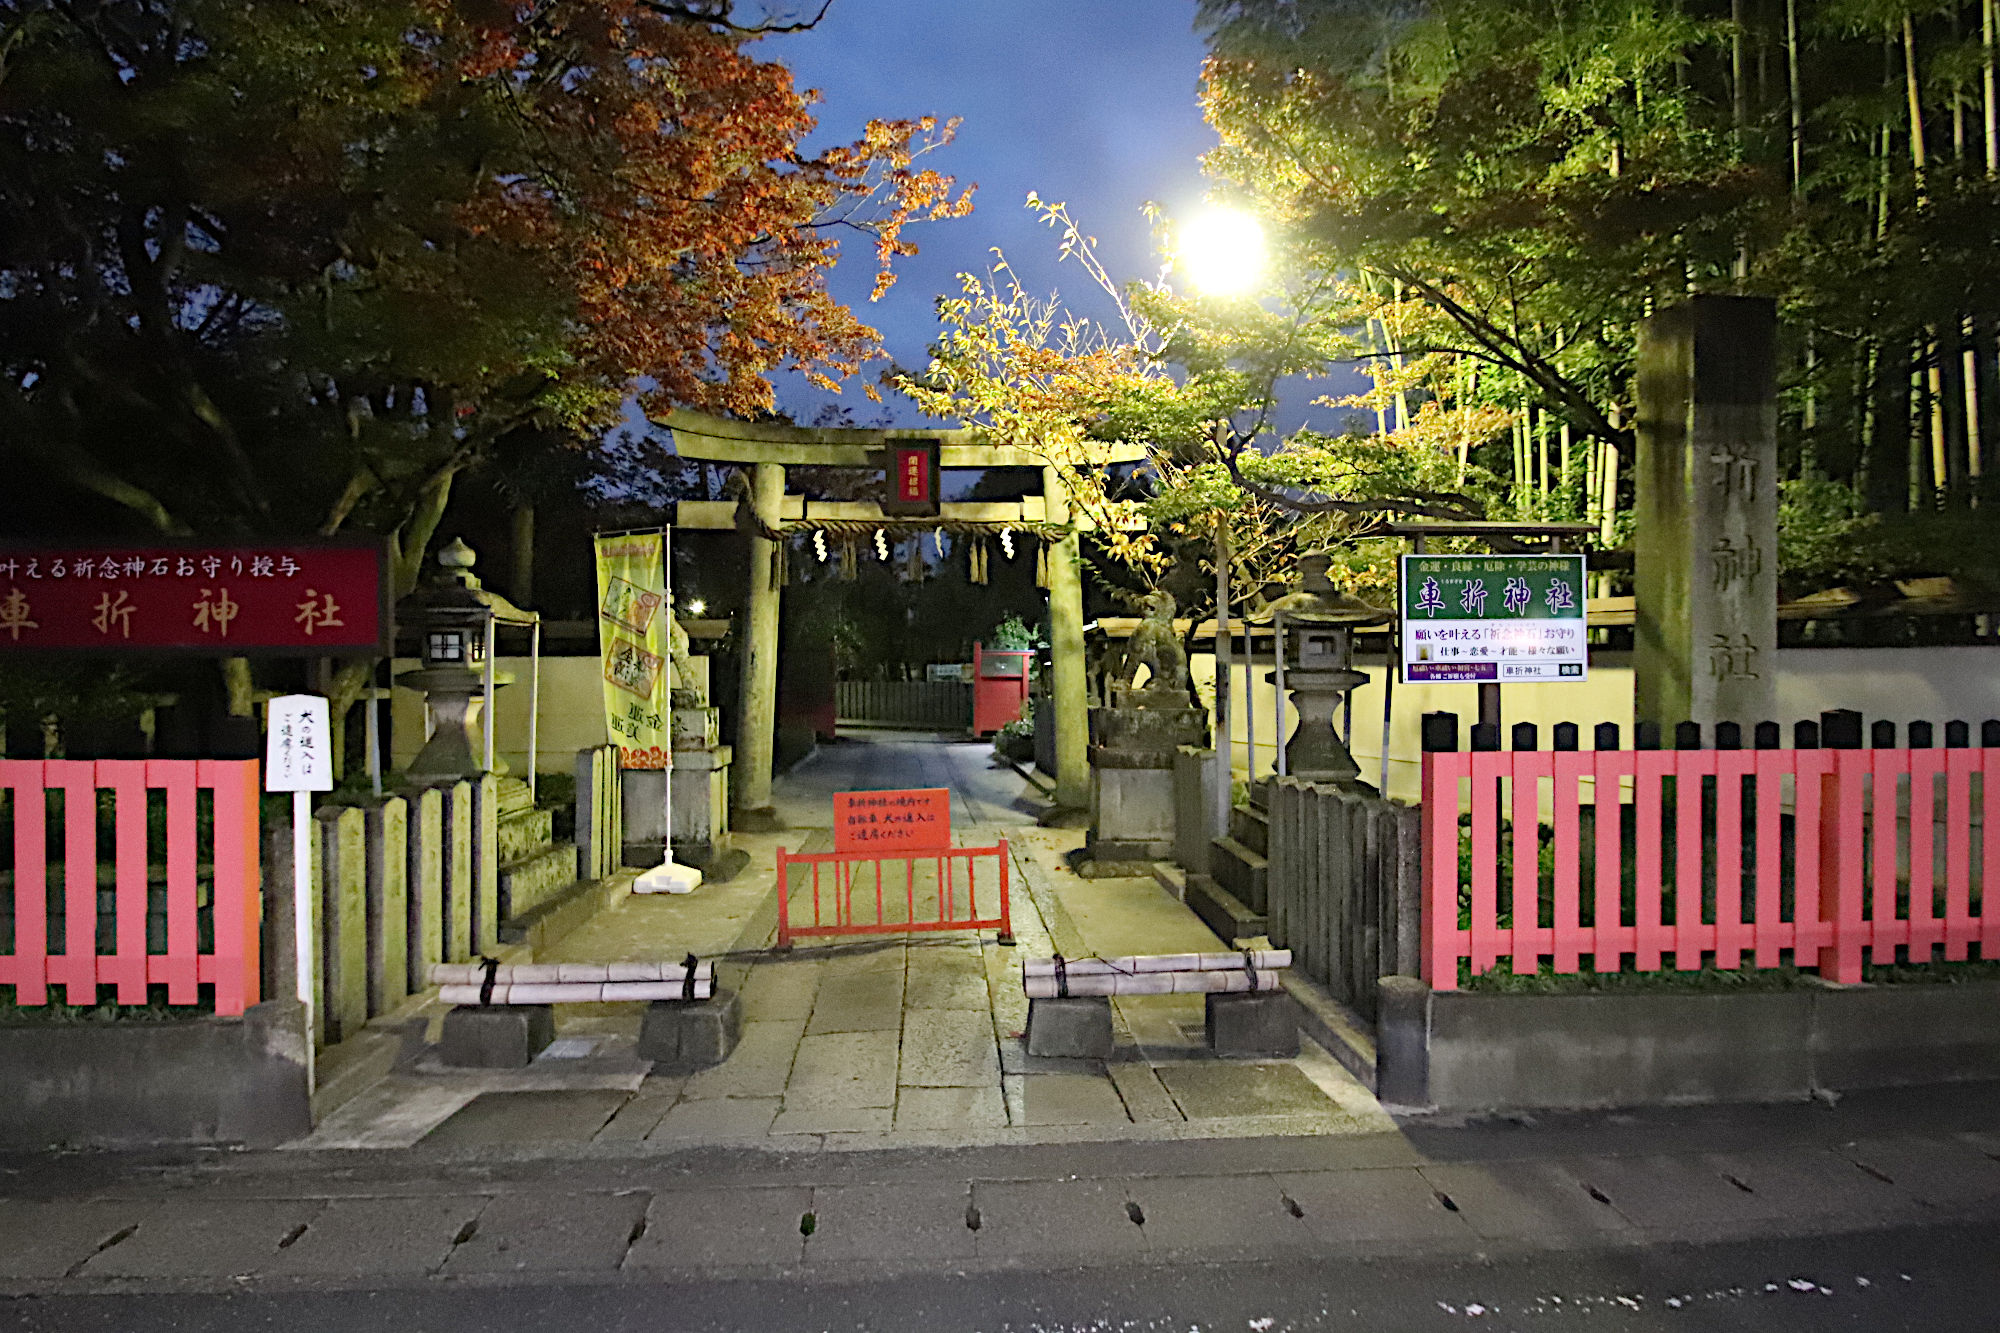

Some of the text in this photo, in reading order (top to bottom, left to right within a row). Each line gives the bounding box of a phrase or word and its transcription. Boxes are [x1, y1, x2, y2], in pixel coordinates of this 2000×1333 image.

[0, 587, 345, 641] 車折神社
[1414, 575, 1575, 618] 車折神社
[1506, 666, 1541, 675] 車折神社
